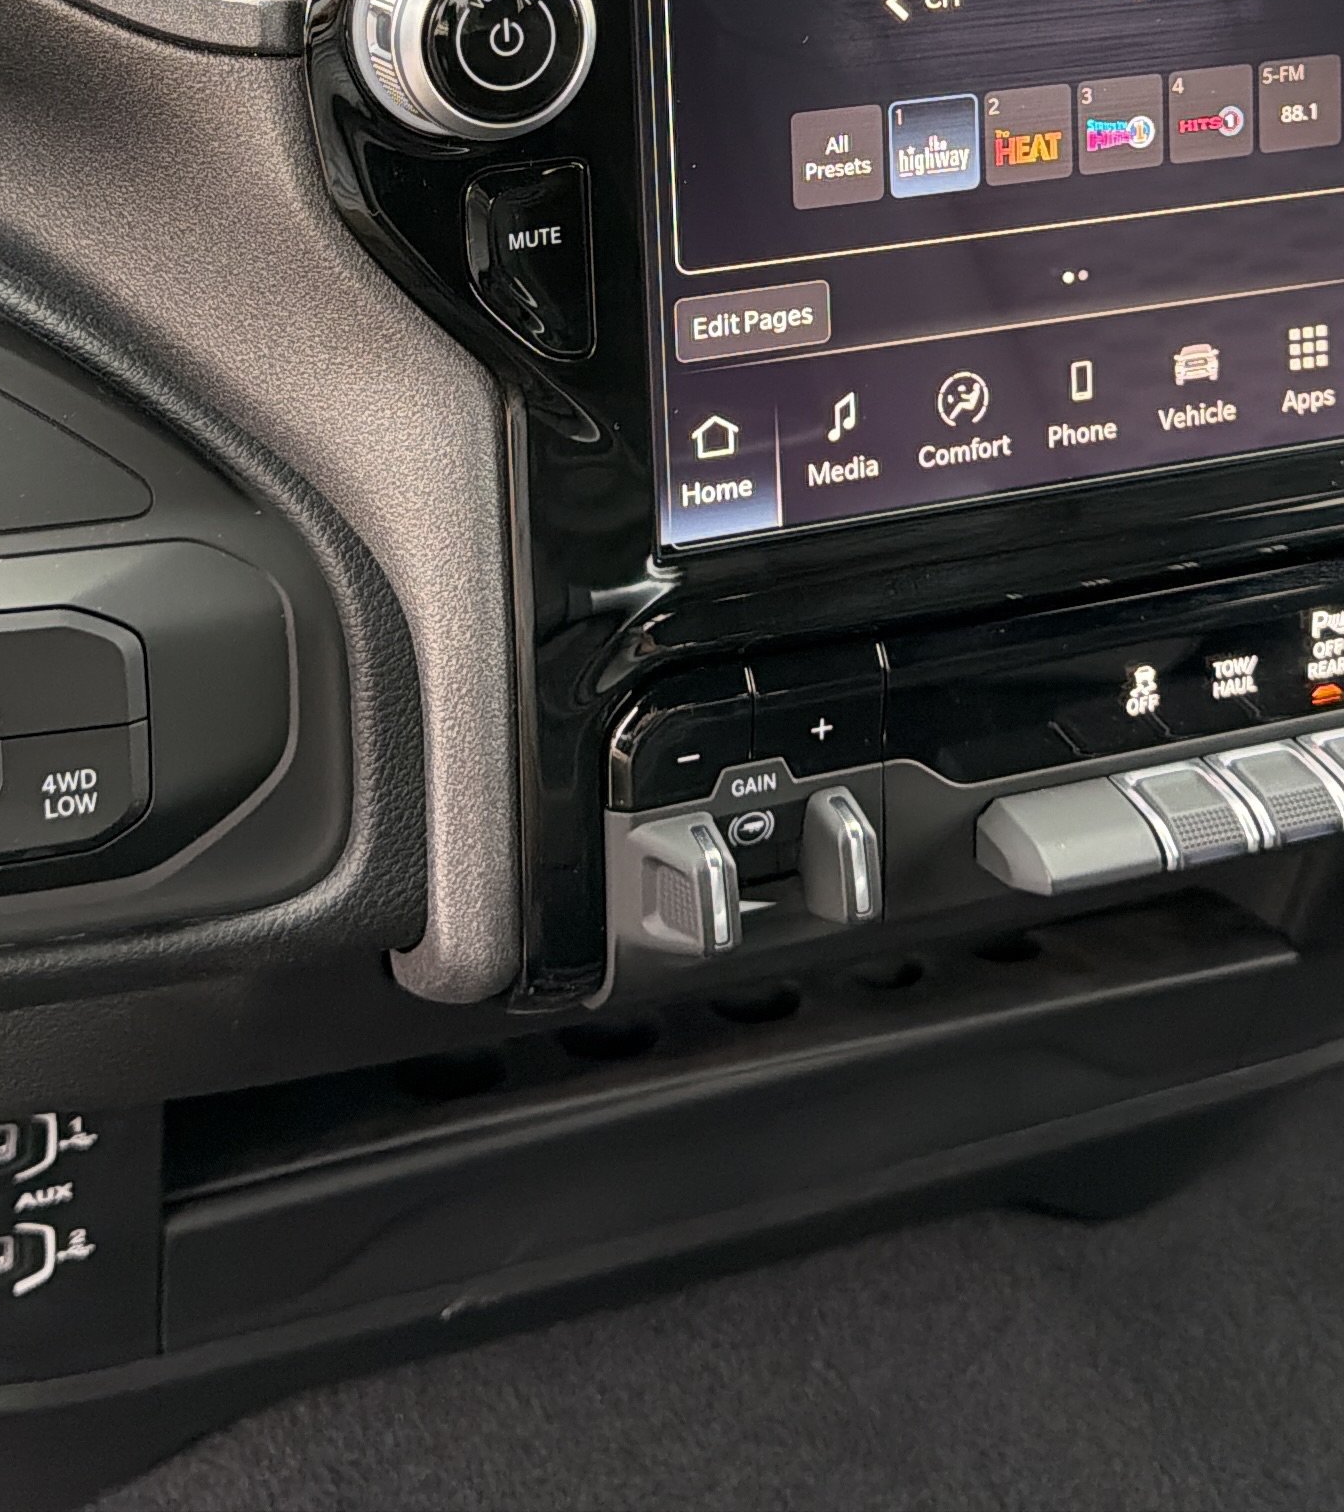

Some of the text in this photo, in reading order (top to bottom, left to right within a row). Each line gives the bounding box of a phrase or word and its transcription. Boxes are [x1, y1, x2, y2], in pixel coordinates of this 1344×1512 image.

[1172, 78, 1184, 94] 4
[1262, 63, 1305, 85] 5-FM
[988, 98, 1000, 116] 2
[1081, 88, 1092, 105] 3
[895, 108, 903, 126] 1
[1281, 103, 1317, 123] 88.1
[825, 136, 849, 155] All
[929, 136, 947, 151] the
[995, 132, 1061, 166] HEAT
[805, 158, 873, 181] Presets
[899, 148, 969, 176] highway
[508, 227, 562, 251] MUTE
[692, 306, 814, 340] Edit Pages
[1281, 388, 1336, 414] Apps
[1158, 400, 1237, 431] Vehicle
[1048, 422, 1118, 448] Phone
[918, 434, 1012, 468] Comfort
[807, 456, 880, 487] Media
[682, 477, 754, 507] Home
[1212, 655, 1258, 678] TOW/
[1212, 676, 1258, 699] HAUL
[1126, 692, 1160, 716] OFF
[41, 768, 97, 796] 4WD
[731, 772, 777, 797] GAIN
[44, 791, 98, 820] LOW
[14, 1181, 74, 1213] AUX
